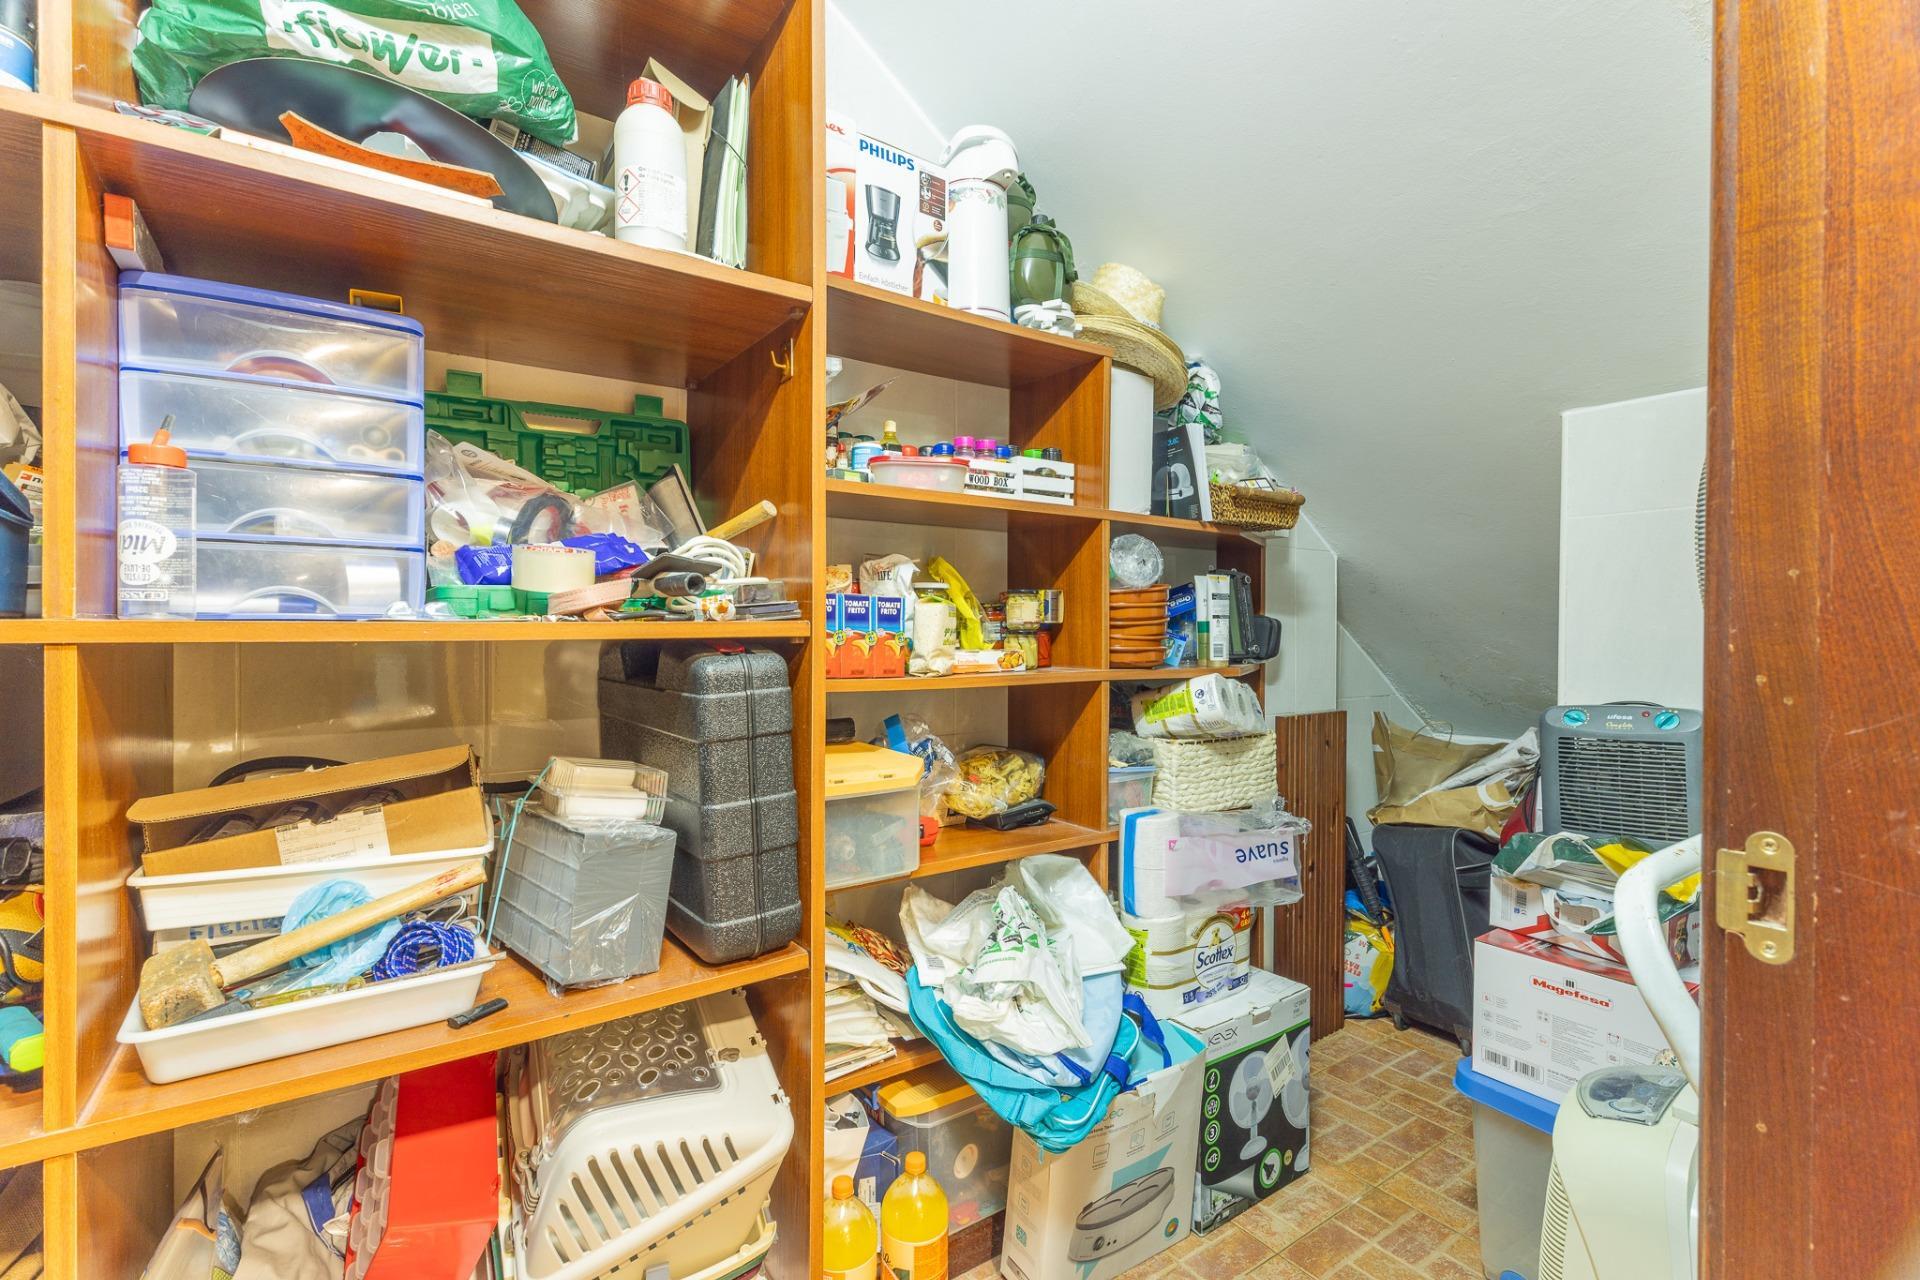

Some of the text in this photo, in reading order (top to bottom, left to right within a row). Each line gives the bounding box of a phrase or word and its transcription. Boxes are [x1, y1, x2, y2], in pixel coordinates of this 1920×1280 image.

[429, 0, 480, 20] bien
[858, 138, 915, 171] PHILIPS
[968, 474, 1009, 488] WOOD BOX
[120, 534, 167, 557] Mid
[845, 600, 869, 608] TOMATE
[878, 601, 901, 609] TOMATE
[1235, 840, 1289, 863] suave
[1195, 944, 1235, 970] Scottex
[1532, 977, 1611, 1009] Magefesa
